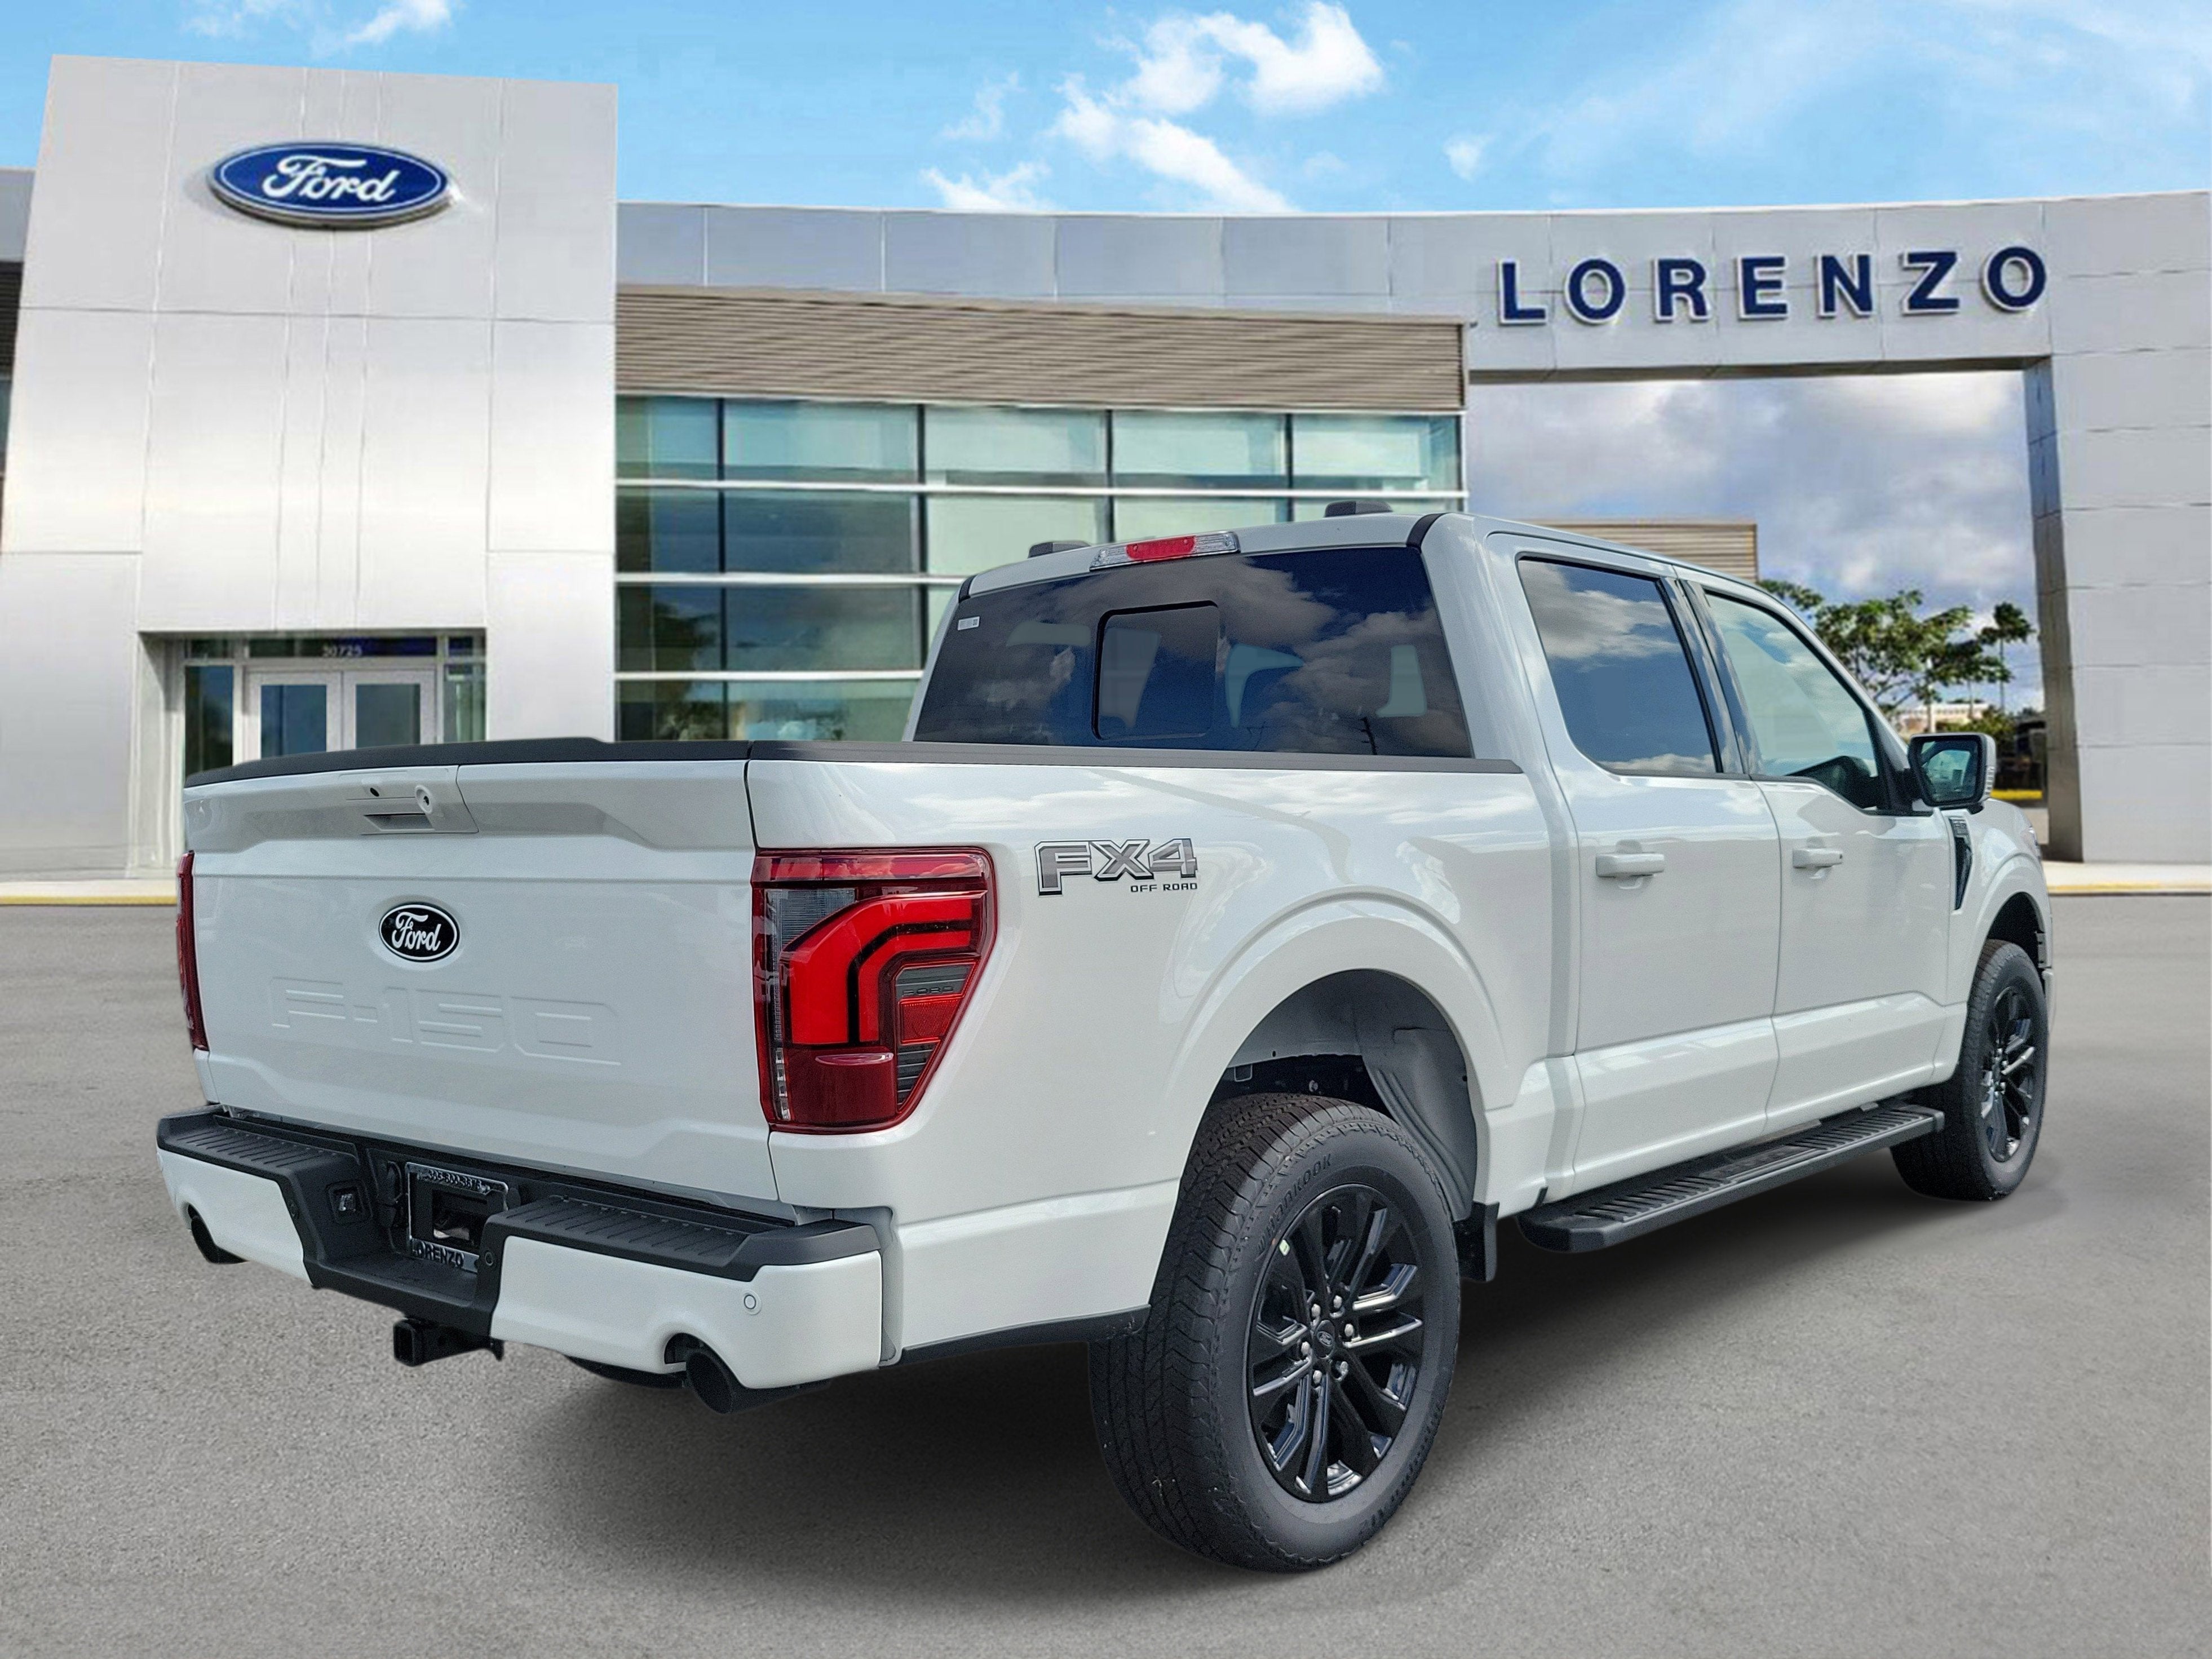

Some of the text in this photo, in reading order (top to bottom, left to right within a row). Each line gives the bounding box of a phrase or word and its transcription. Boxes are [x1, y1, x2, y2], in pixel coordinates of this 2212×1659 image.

[262, 154, 400, 202] Ford
[1498, 246, 2047, 325] LORENZO
[1034, 838, 1198, 896] FX4
[1162, 883, 1198, 891] ROAD
[391, 911, 442, 952] Ford
[903, 986, 953, 996] FORD
[271, 976, 621, 1065] F-150
[412, 1239, 464, 1268] LORENZO
